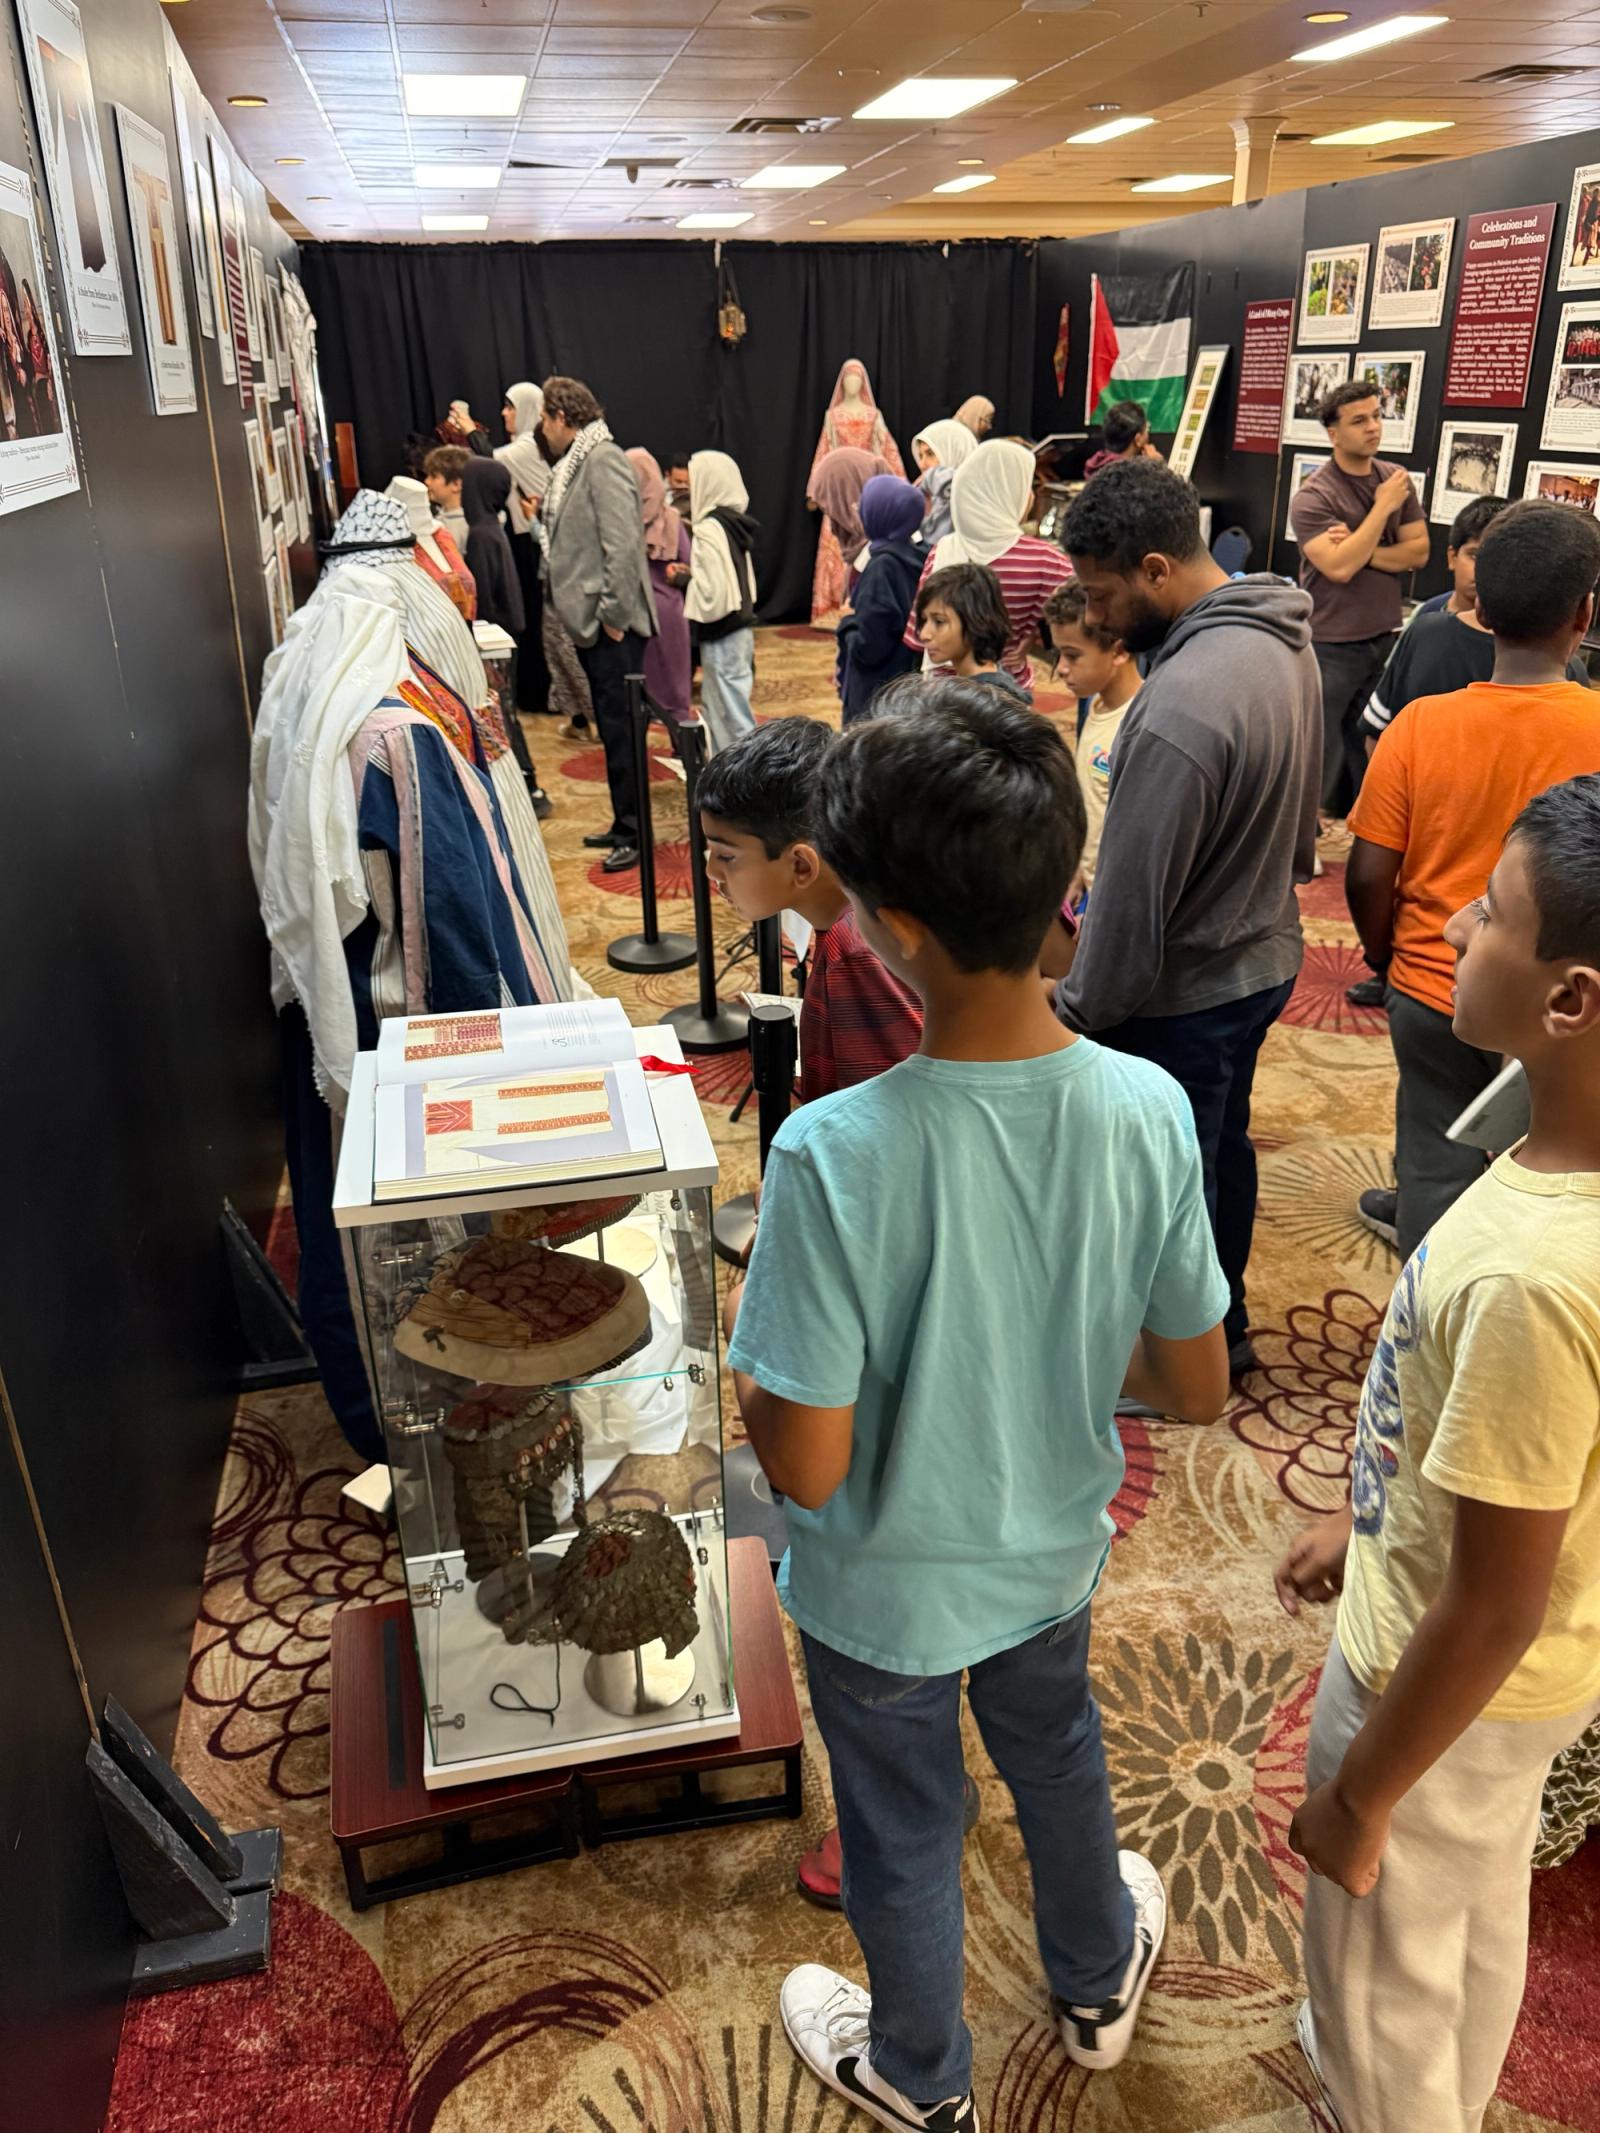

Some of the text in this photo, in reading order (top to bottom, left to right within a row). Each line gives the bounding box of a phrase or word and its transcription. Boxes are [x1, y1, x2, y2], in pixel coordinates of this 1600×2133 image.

[1481, 216, 1538, 233] Celebrations and
[1469, 232, 1545, 249] Community Traditions
